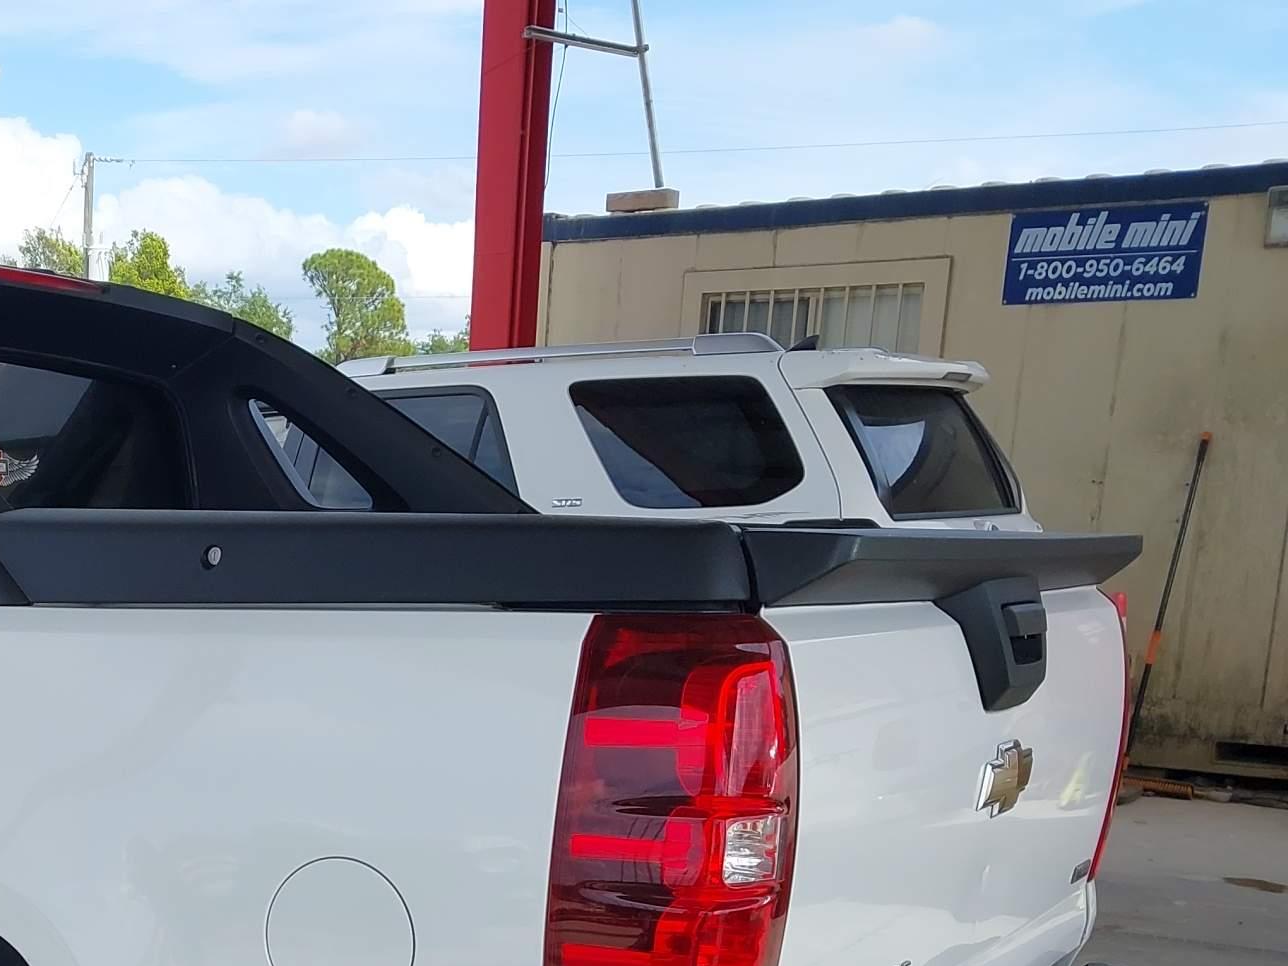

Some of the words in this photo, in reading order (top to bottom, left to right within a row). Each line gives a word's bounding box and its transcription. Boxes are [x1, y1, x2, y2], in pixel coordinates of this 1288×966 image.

[1014, 211, 1121, 254] mobile
[1122, 211, 1201, 249] mini
[1018, 255, 1186, 281] 1-800-950-6464
[1025, 280, 1174, 302] mobilemini.com
